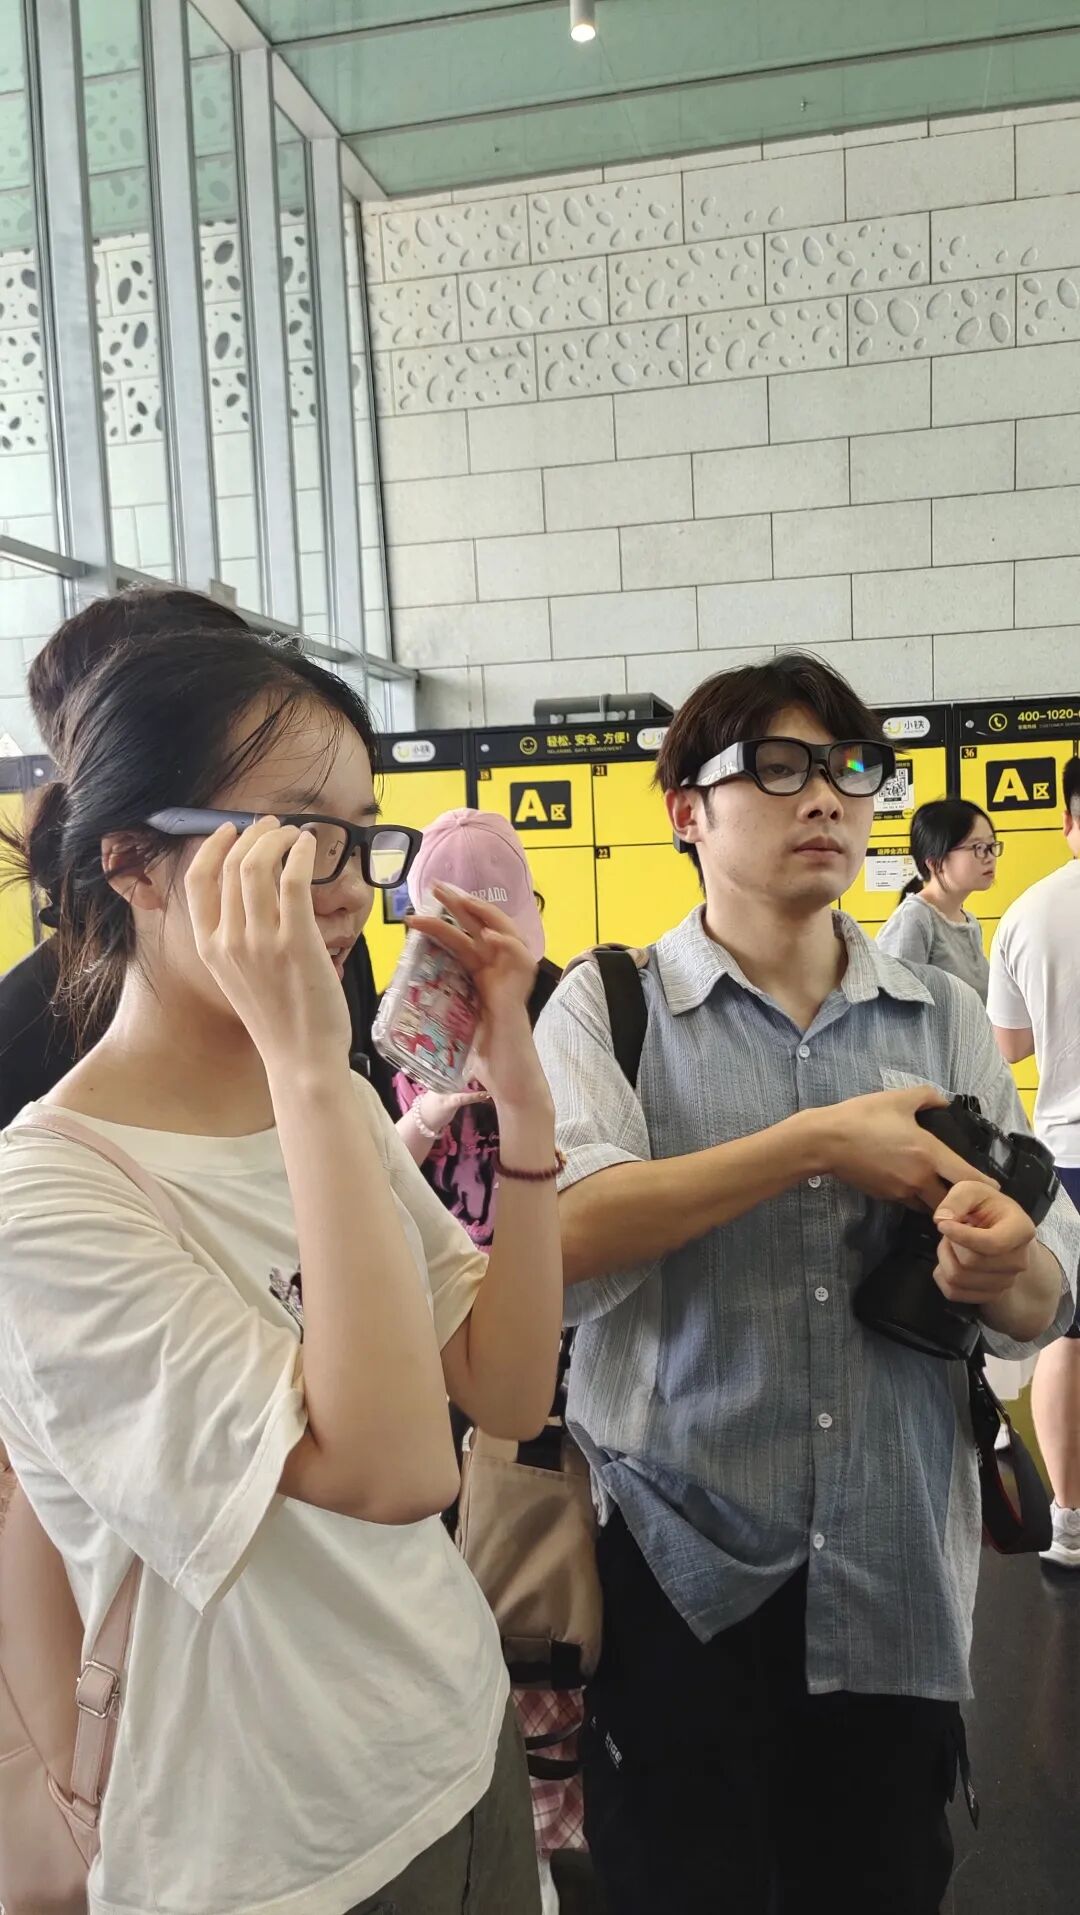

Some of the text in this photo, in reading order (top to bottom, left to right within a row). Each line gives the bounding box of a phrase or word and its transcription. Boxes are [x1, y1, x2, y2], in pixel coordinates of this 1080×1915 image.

[1018, 709, 1080, 721] 400-1020-
[964, 748, 974, 758] 36
[595, 766, 605, 775] 21
[597, 849, 608, 858] 22
[471, 887, 508, 902] ORADO
